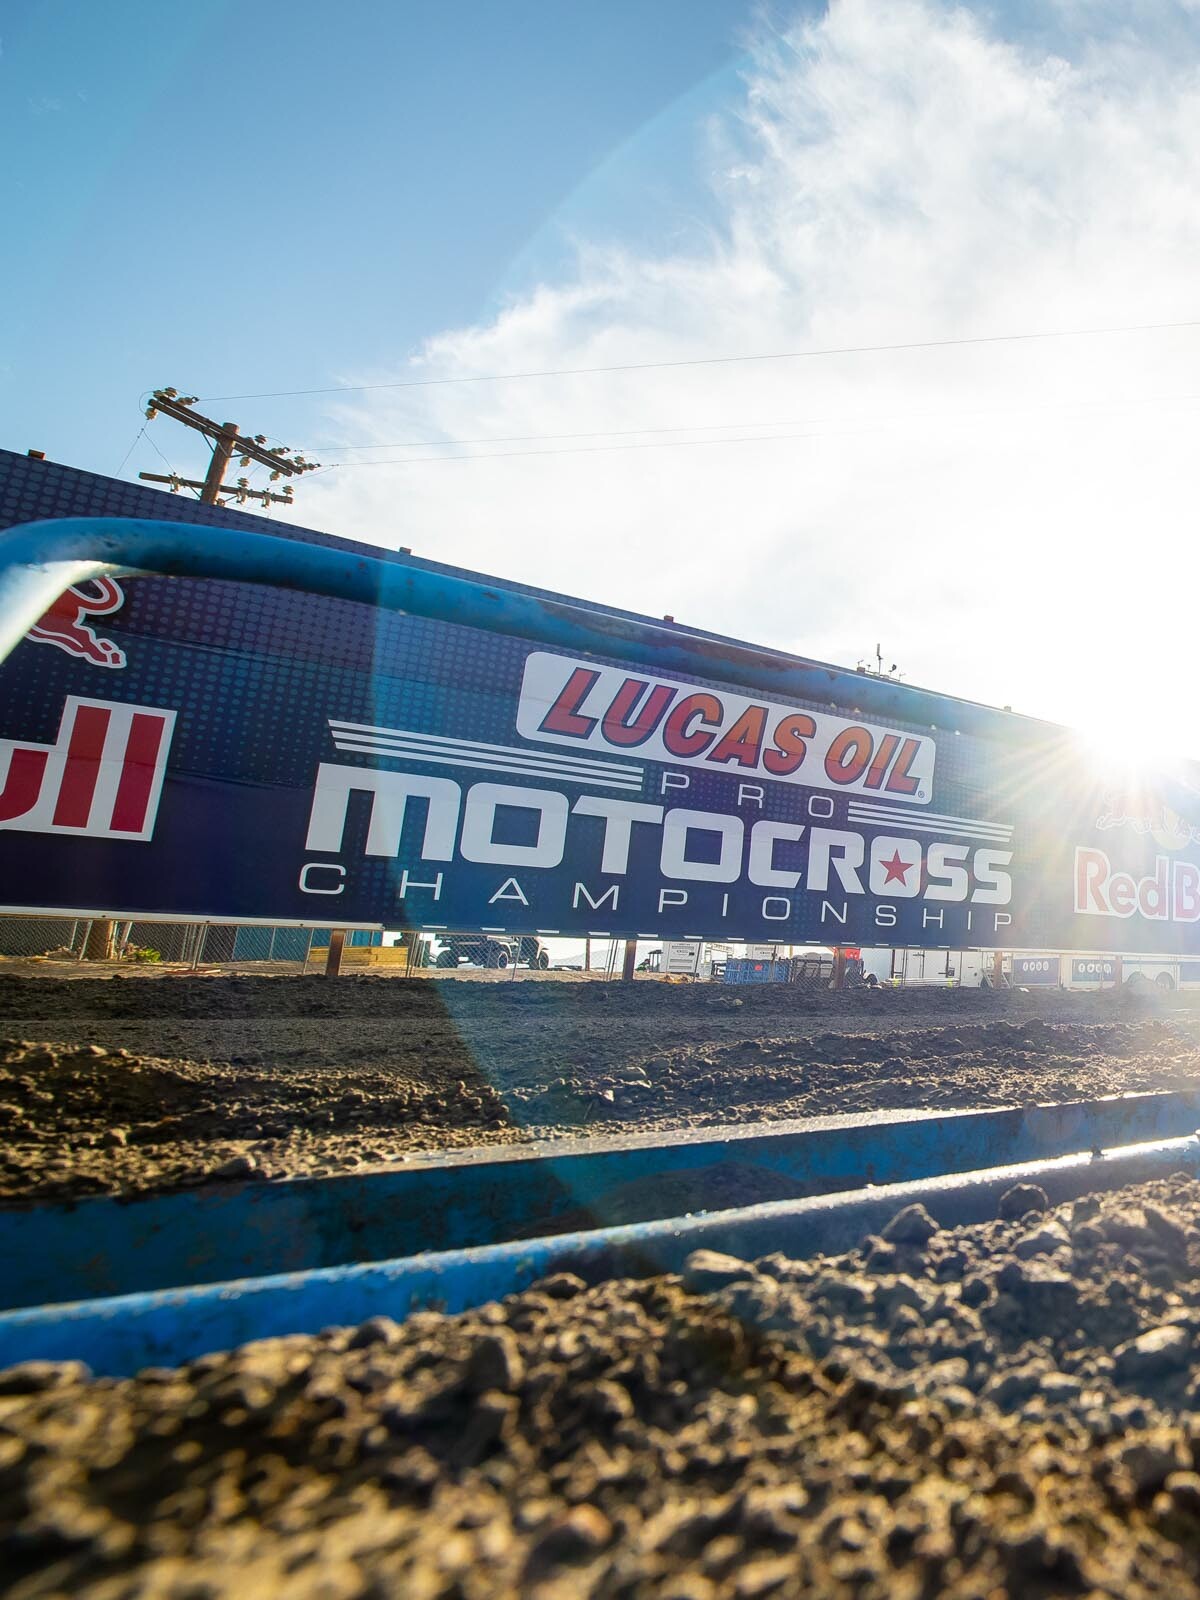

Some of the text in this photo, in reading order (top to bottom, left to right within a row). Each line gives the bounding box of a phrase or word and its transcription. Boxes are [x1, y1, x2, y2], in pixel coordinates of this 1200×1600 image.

[537, 666, 922, 796] LUCAS OIL
[660, 770, 835, 820] PRO
[304, 762, 1015, 906] MOTOCROSS
[298, 862, 1013, 932] CHAMPIONSHIP
[1075, 847, 1169, 920] Red
